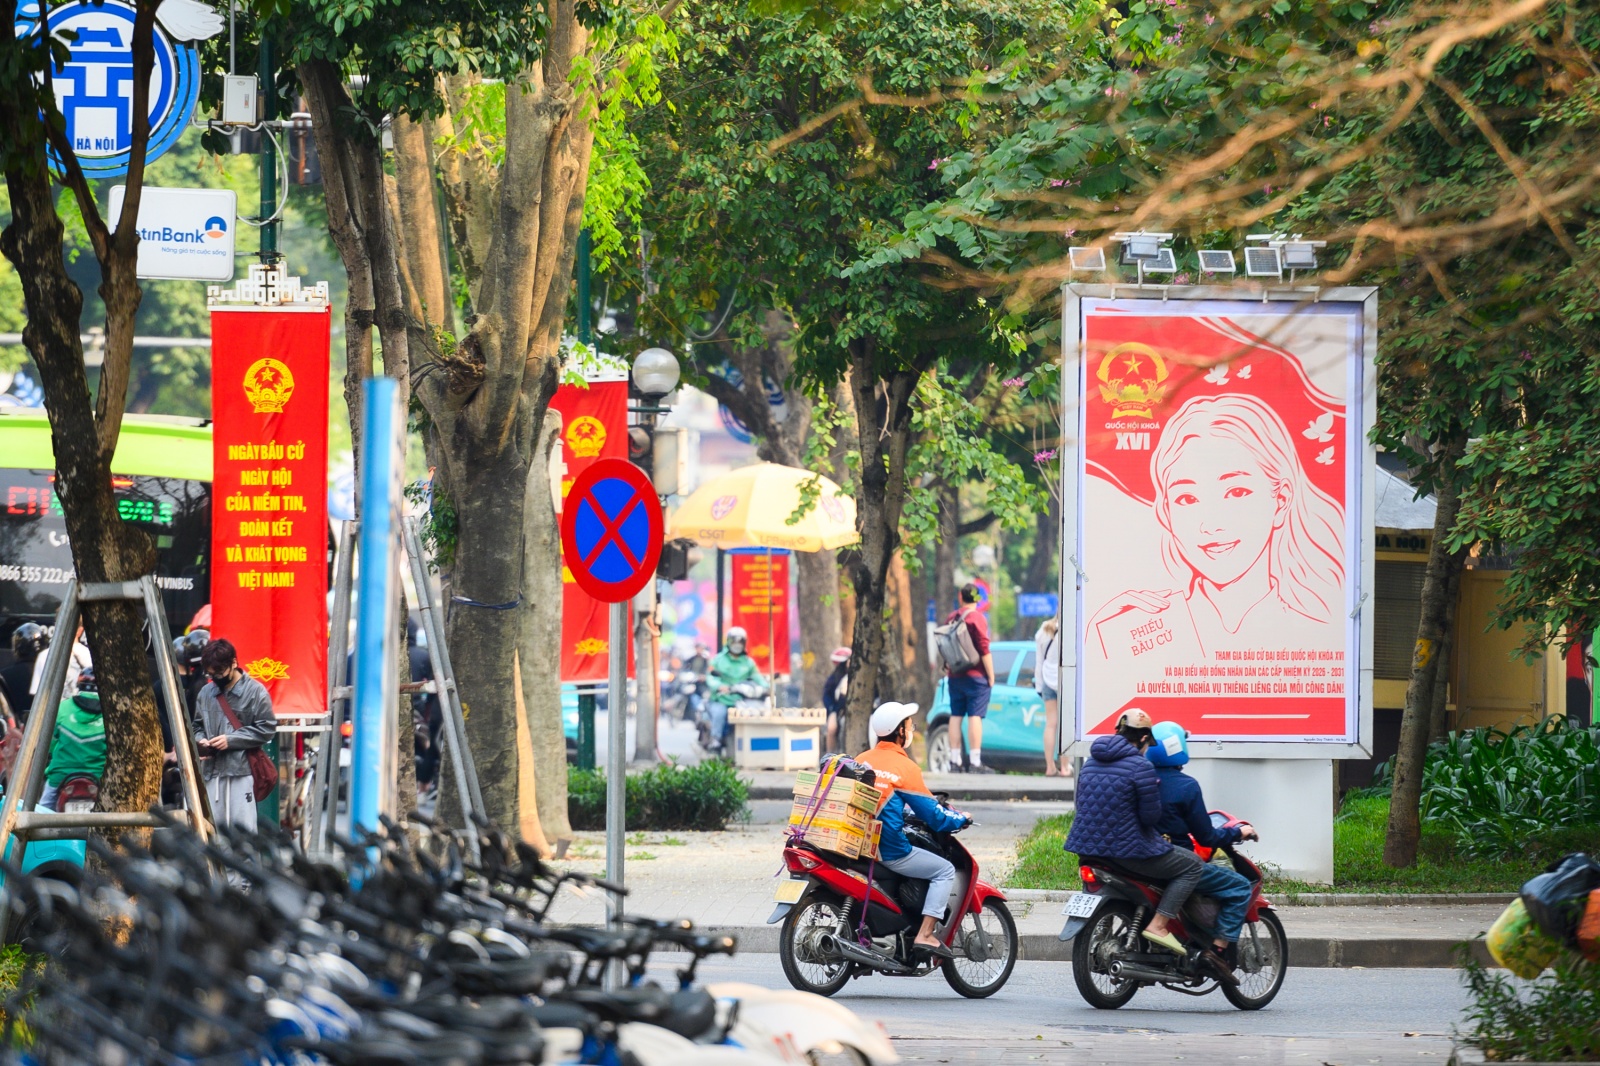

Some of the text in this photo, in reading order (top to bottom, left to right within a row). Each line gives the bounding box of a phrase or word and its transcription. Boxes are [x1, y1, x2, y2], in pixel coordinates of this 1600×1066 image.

[76, 138, 115, 153] HÀ NỘI
[1105, 420, 1160, 431] QUỐC HỘI KHOÁ
[228, 440, 305, 460] NGÀY BẦU CỬ
[1115, 432, 1151, 451] XVI
[240, 467, 292, 489] NGÀY HỘI
[226, 491, 307, 513] CỦA NIỀM TIN,
[239, 517, 293, 537] ĐOÀN KẾT
[699, 529, 725, 540] CSGT
[226, 544, 307, 565] VÀ KHÁT VỌNG
[0, 565, 20, 581] 866
[21, 566, 42, 583] 355
[42, 567, 63, 584] 222
[164, 576, 194, 590] VINBUS
[238, 569, 295, 591] VIỆT NAM!
[1130, 618, 1164, 640] PHIẾU
[1131, 629, 1173, 656] BẦU CỬ
[1215, 647, 1344, 662] THAM GIA BẦU CỬ ĐẠI BIỂU QUỐC HỘI KHÓA XVI
[1164, 665, 1173, 677] VÀ
[1174, 667, 1184, 679] ĐẠI
[1185, 663, 1198, 677] BIỂU
[1200, 665, 1209, 679] HỘI
[1210, 664, 1226, 677] ĐỒNG
[1227, 665, 1243, 677] NHÂN
[1244, 665, 1256, 677] DÂN
[1258, 665, 1269, 677] CÁC
[1270, 664, 1282, 677] CẤP
[1283, 665, 1302, 679] NHIỆM
[1303, 665, 1311, 677] KỲ
[1331, 667, 1345, 677] 2031
[1137, 679, 1344, 696] LÀ QUYỀN LỢI, NGHĨA VỤ THIÊNG LIÊNG CỦA MỖI CÔNG DÂN!
